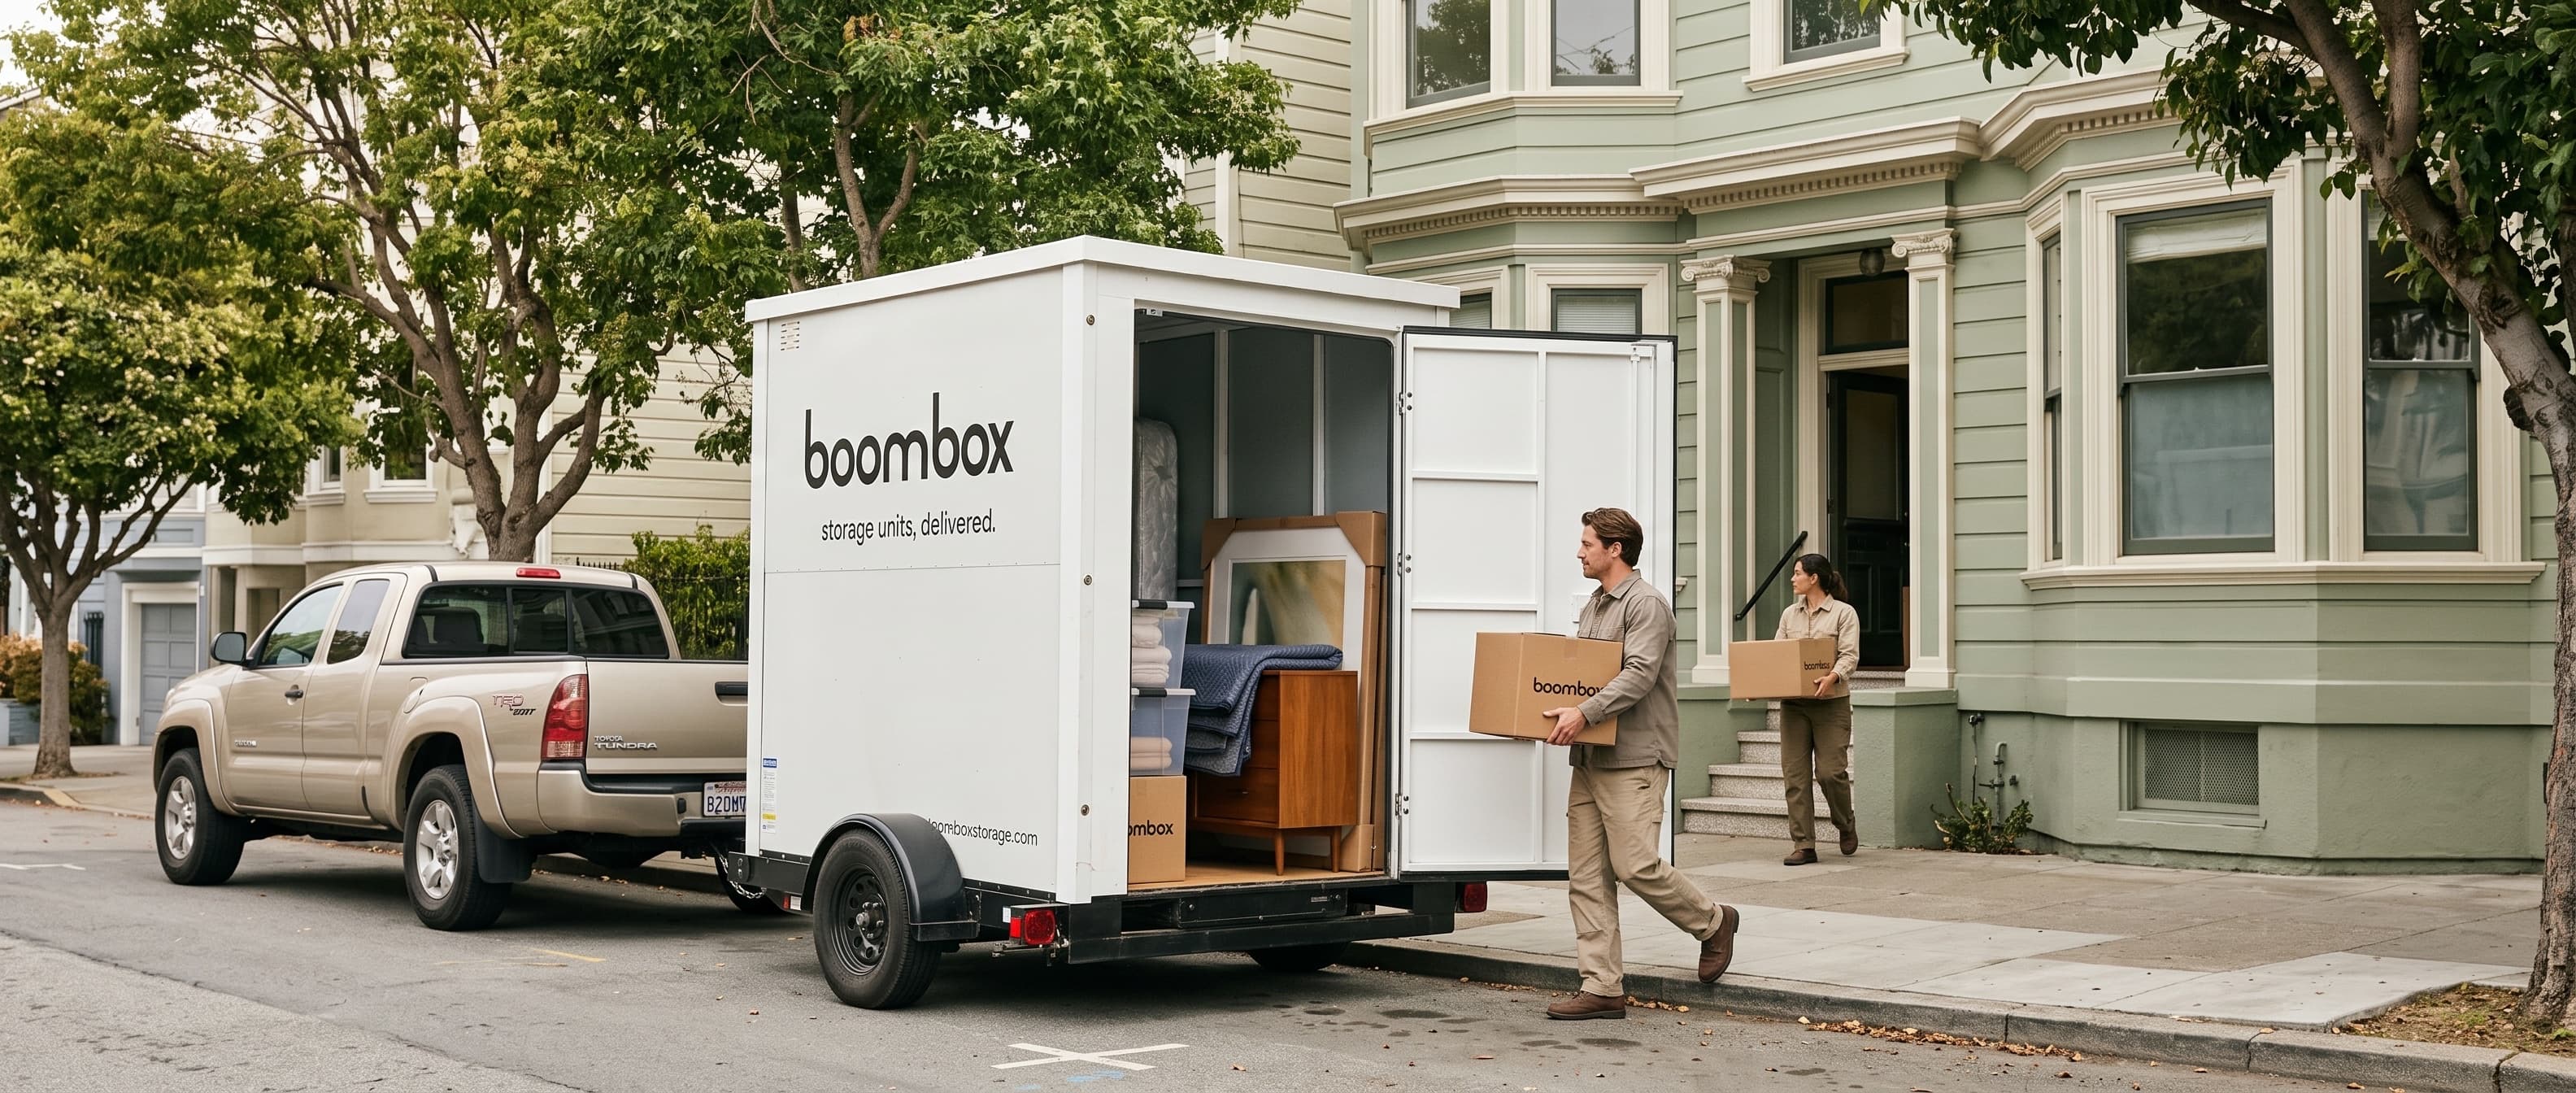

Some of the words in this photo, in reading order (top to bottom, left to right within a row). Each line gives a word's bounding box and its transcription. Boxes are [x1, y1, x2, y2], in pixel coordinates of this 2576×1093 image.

[804, 391, 1015, 490] boombox
[821, 520, 874, 546] storage
[878, 514, 916, 541] units,
[921, 507, 996, 536] delivered.
